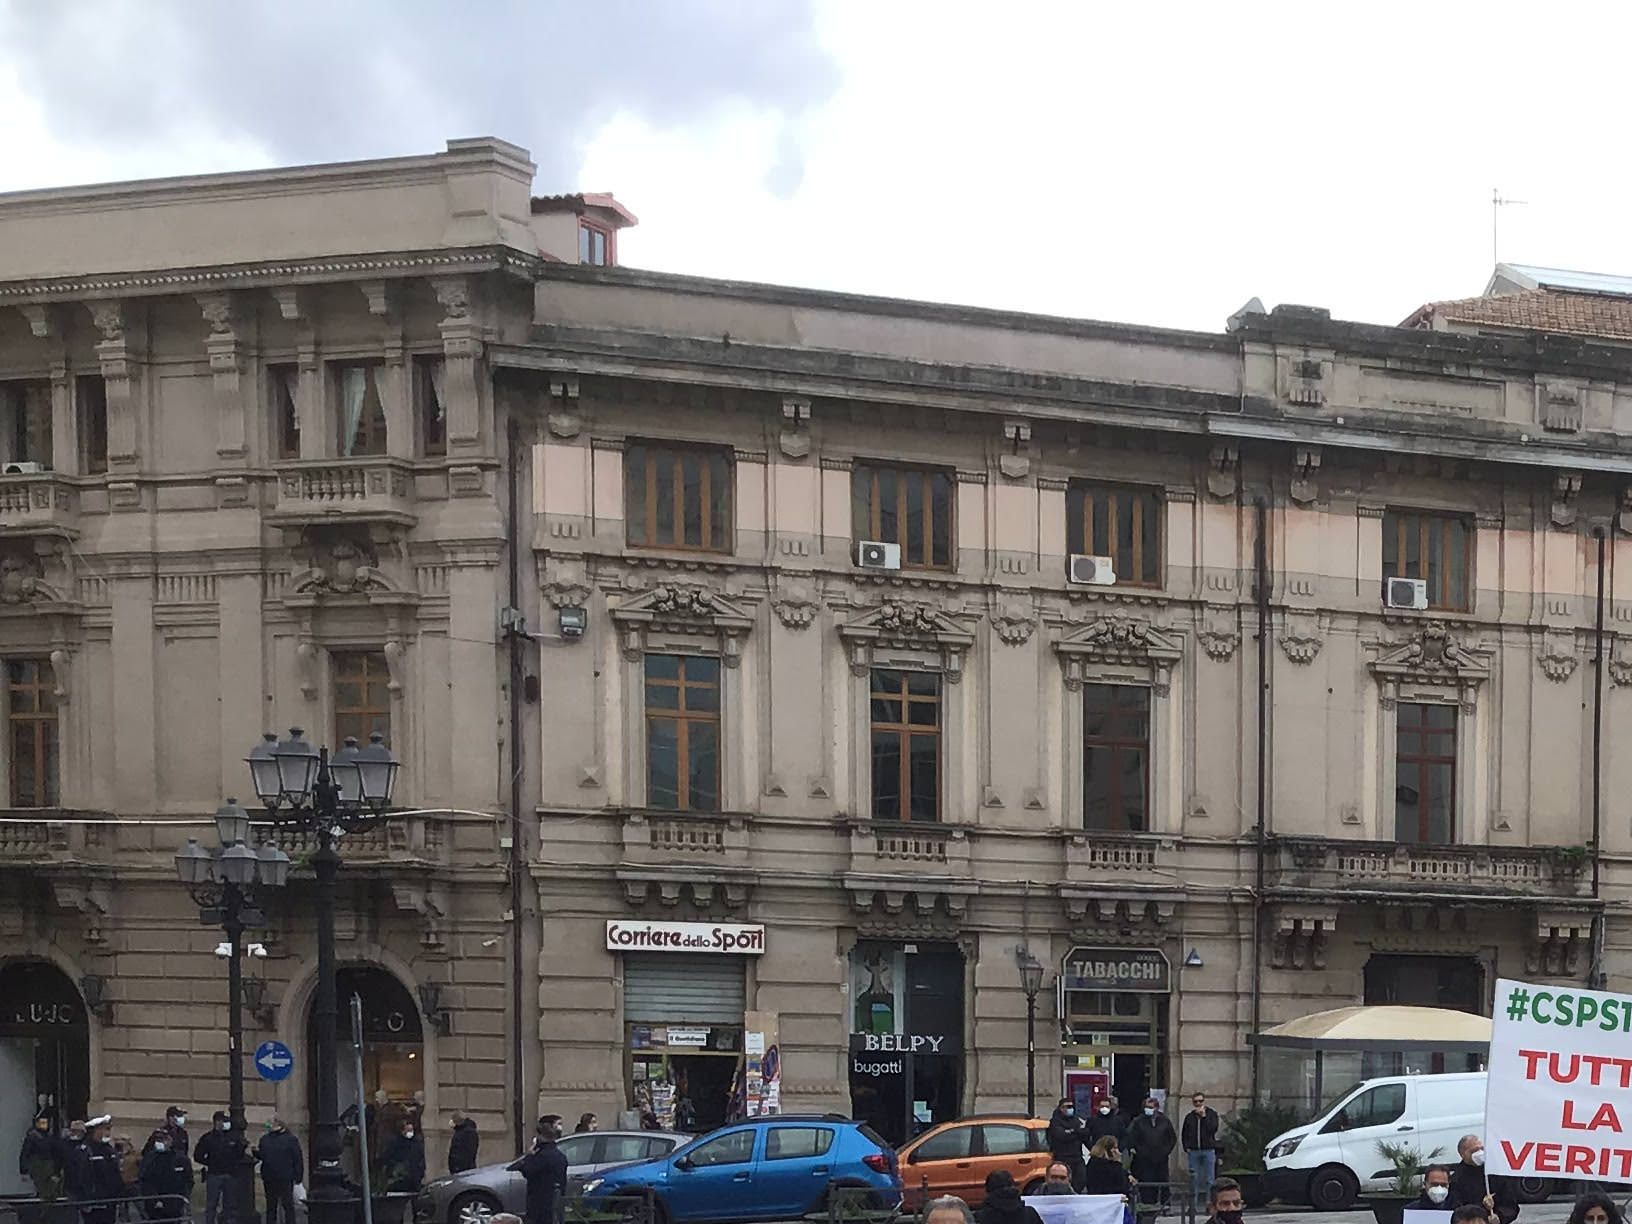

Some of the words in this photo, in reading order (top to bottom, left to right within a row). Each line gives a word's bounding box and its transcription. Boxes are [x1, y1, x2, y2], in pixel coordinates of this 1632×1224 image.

[608, 924, 682, 946] Corriere
[682, 935, 710, 948] dello
[711, 928, 764, 951] Sport
[1073, 961, 1160, 979] TABACCHI
[865, 1034, 944, 1052] BELPY
[854, 1059, 902, 1077] bugatti
[1562, 1100, 1623, 1133] LA
